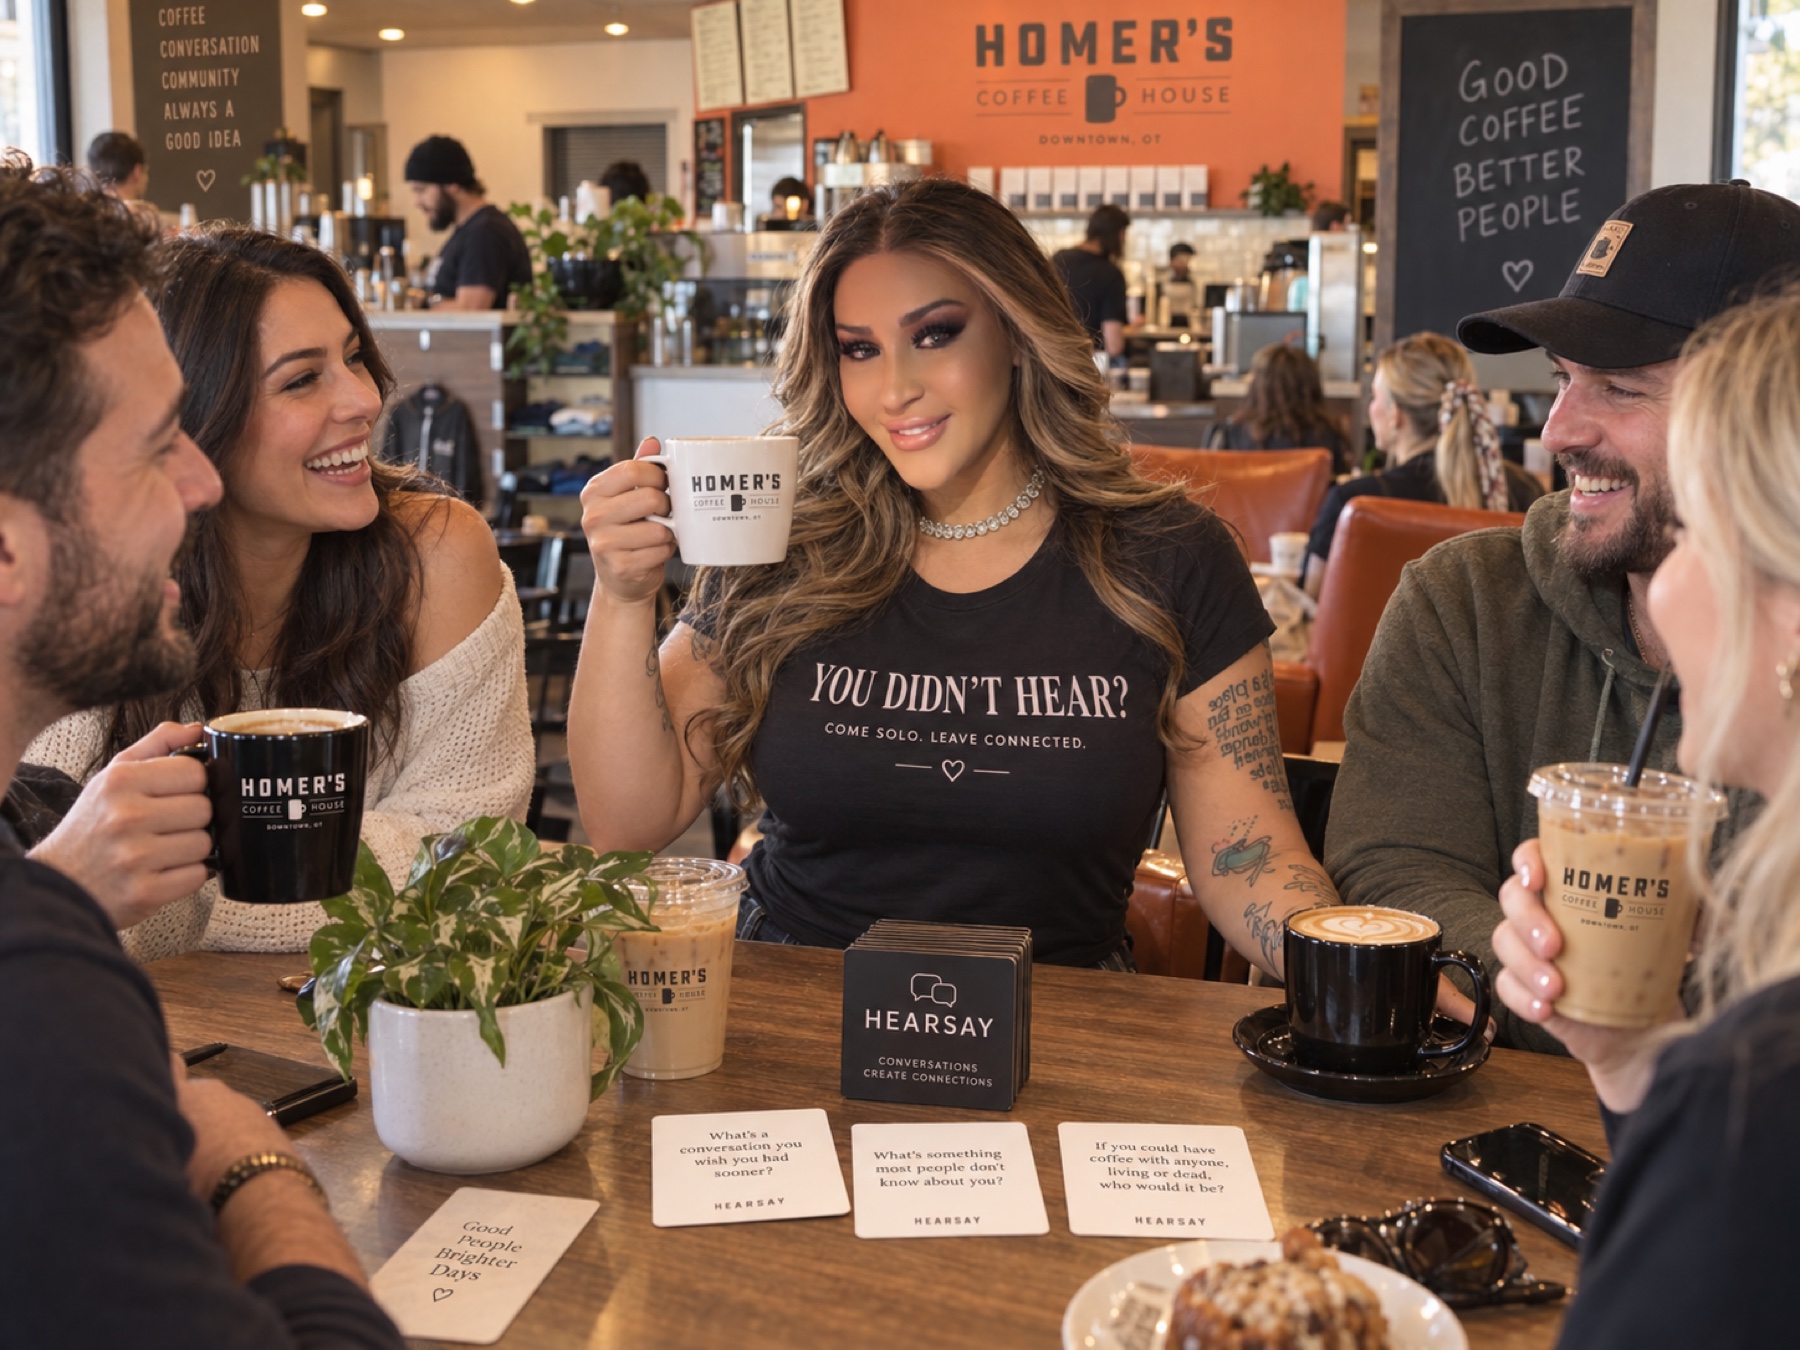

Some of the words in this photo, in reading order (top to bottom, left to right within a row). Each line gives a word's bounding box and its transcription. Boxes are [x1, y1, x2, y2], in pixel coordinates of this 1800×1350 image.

[158, 6, 205, 26] COFFEE
[160, 35, 260, 58] CONVERSATION
[975, 17, 1233, 67] HOMER'S
[161, 68, 240, 90] COMMUNITY
[1458, 52, 1569, 102] GOOD
[976, 88, 1068, 106] COFFEE
[1142, 86, 1230, 104] HOUSE
[164, 101, 217, 121] ALWAYS
[225, 100, 235, 118] A
[1458, 93, 1585, 147] COFFEE
[165, 132, 200, 150] GOOD
[209, 129, 242, 148] IDEA
[1039, 135, 1136, 146] DOWNTOWN,
[1142, 134, 1161, 145] OT
[1453, 146, 1585, 198] BETTER
[1457, 188, 1582, 242] PEOPLE
[691, 473, 781, 492] HOMER'S
[810, 662, 878, 707] YOU
[882, 671, 1003, 716] DIDN'T
[1013, 675, 1129, 719] HEAR?
[824, 722, 870, 738] COME
[876, 727, 923, 743] SOLO.
[931, 731, 978, 746] LEAVE
[984, 734, 1086, 750] CONNECTED.
[241, 773, 345, 797] HOMER'S
[242, 805, 281, 814] COFFEE
[311, 800, 344, 811] HOUSE
[1563, 867, 1670, 898] HOMER'S
[1562, 894, 1597, 909] COFFEE
[1629, 905, 1664, 916] HOUSE
[628, 968, 706, 985] HOMER'S
[865, 1008, 994, 1038] HEARSAY
[878, 1056, 978, 1073] CONVERSATIONS
[863, 1068, 907, 1080] CREATE
[912, 1072, 993, 1088] CONNECTIONS
[709, 1130, 757, 1140] What's
[680, 1142, 771, 1154] conversation
[776, 1141, 803, 1151] you
[874, 1150, 922, 1160] What's
[926, 1149, 1003, 1160] something
[1095, 1142, 1107, 1150] If
[1110, 1143, 1136, 1152] you
[1140, 1144, 1179, 1153] could
[1183, 1145, 1216, 1154] have
[694, 1156, 727, 1166] wish
[732, 1155, 758, 1166] you
[762, 1152, 789, 1163] had
[875, 1164, 912, 1173] most
[917, 1162, 965, 1174] people
[969, 1162, 1006, 1172] don't
[1089, 1154, 1134, 1163] coffee
[1139, 1156, 1170, 1165] with
[1174, 1158, 1229, 1168] anyone,
[714, 1166, 773, 1177] sooner?
[1108, 1167, 1149, 1179] living
[1173, 1169, 1212, 1180] dead,
[880, 1177, 919, 1187] know
[924, 1176, 964, 1186] about
[970, 1176, 1003, 1188] you?
[1099, 1181, 1131, 1190] who
[1136, 1182, 1180, 1192] would
[1185, 1183, 1195, 1192] it
[1200, 1183, 1224, 1193] be?
[714, 1197, 784, 1210] HEARSAY
[462, 1221, 514, 1236] Good
[914, 1216, 981, 1225] HEARSAY
[1135, 1216, 1206, 1226] HEARSAY
[457, 1235, 522, 1253] People
[434, 1247, 517, 1269] Brighter
[430, 1263, 482, 1282] Days
